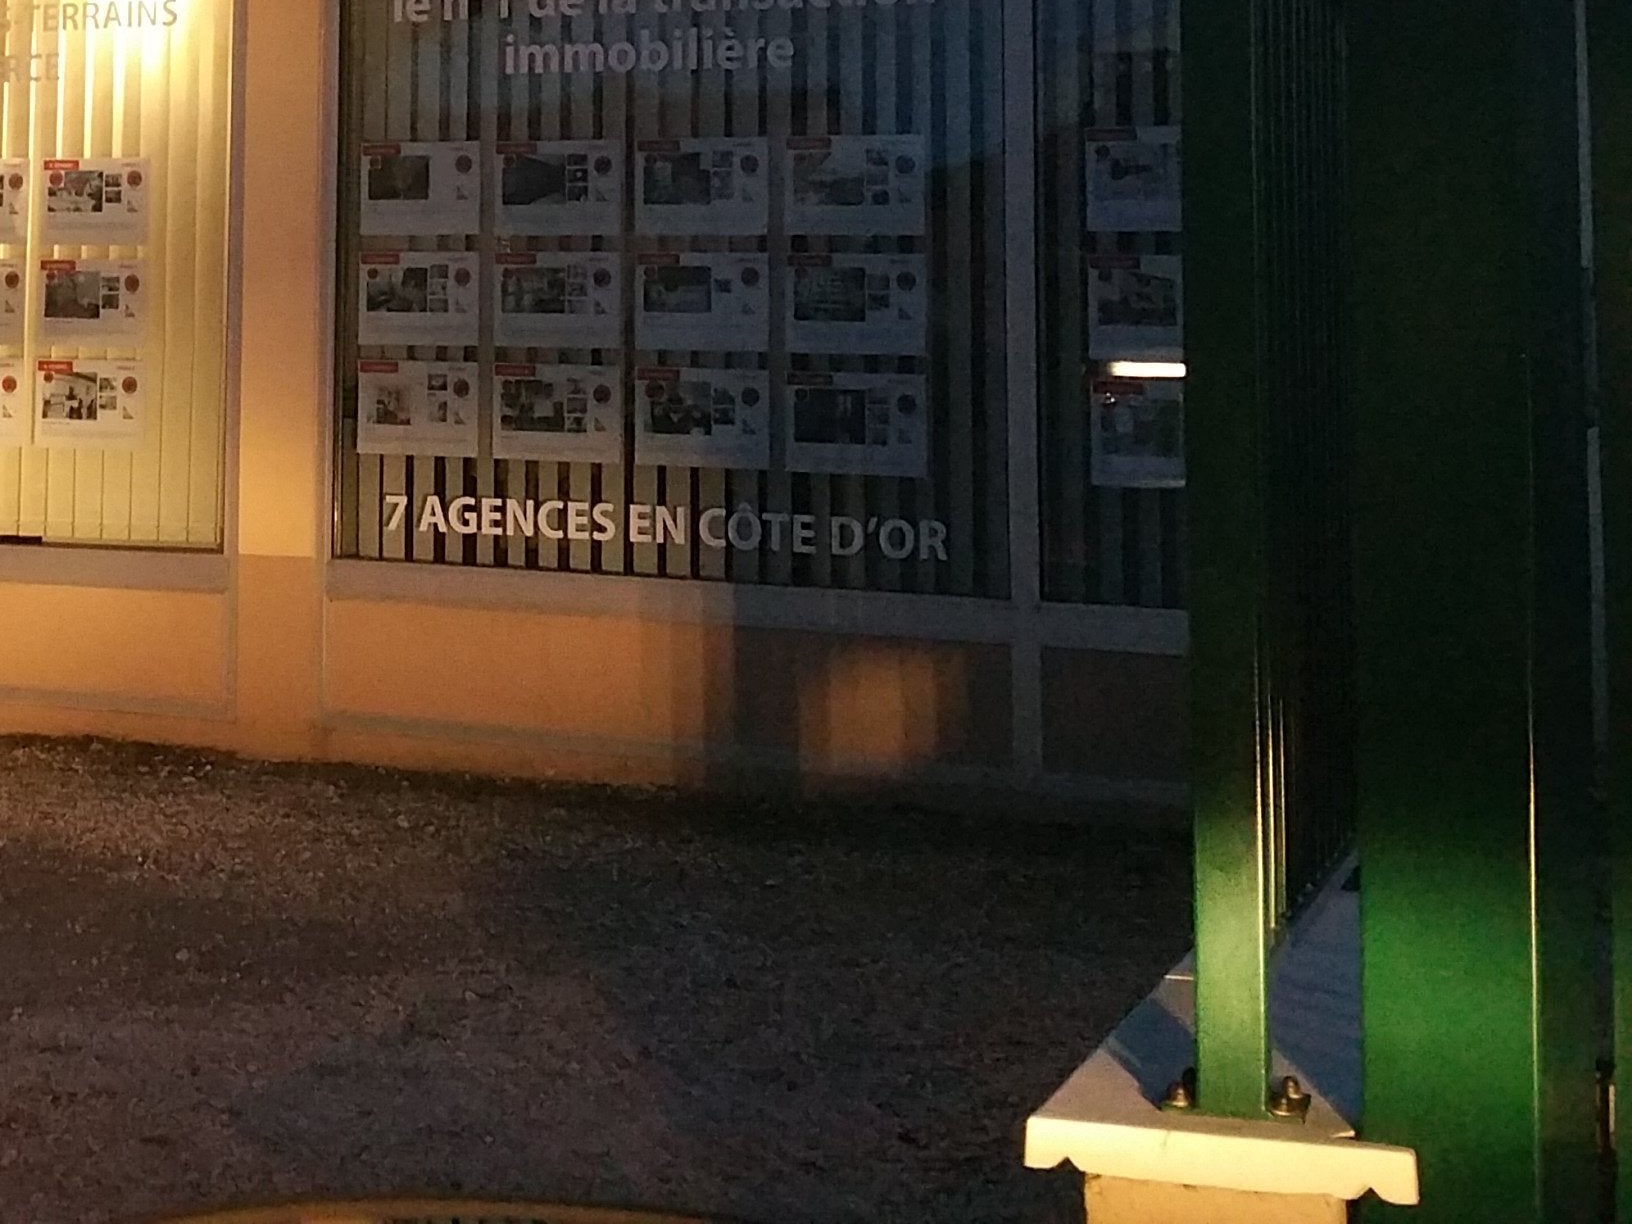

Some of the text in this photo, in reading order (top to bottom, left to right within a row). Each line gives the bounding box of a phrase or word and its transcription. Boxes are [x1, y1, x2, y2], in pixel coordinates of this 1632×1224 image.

[504, 26, 795, 76] immobilière
[384, 495, 949, 562] 7 AGENCES EN CÔTE D'OR
